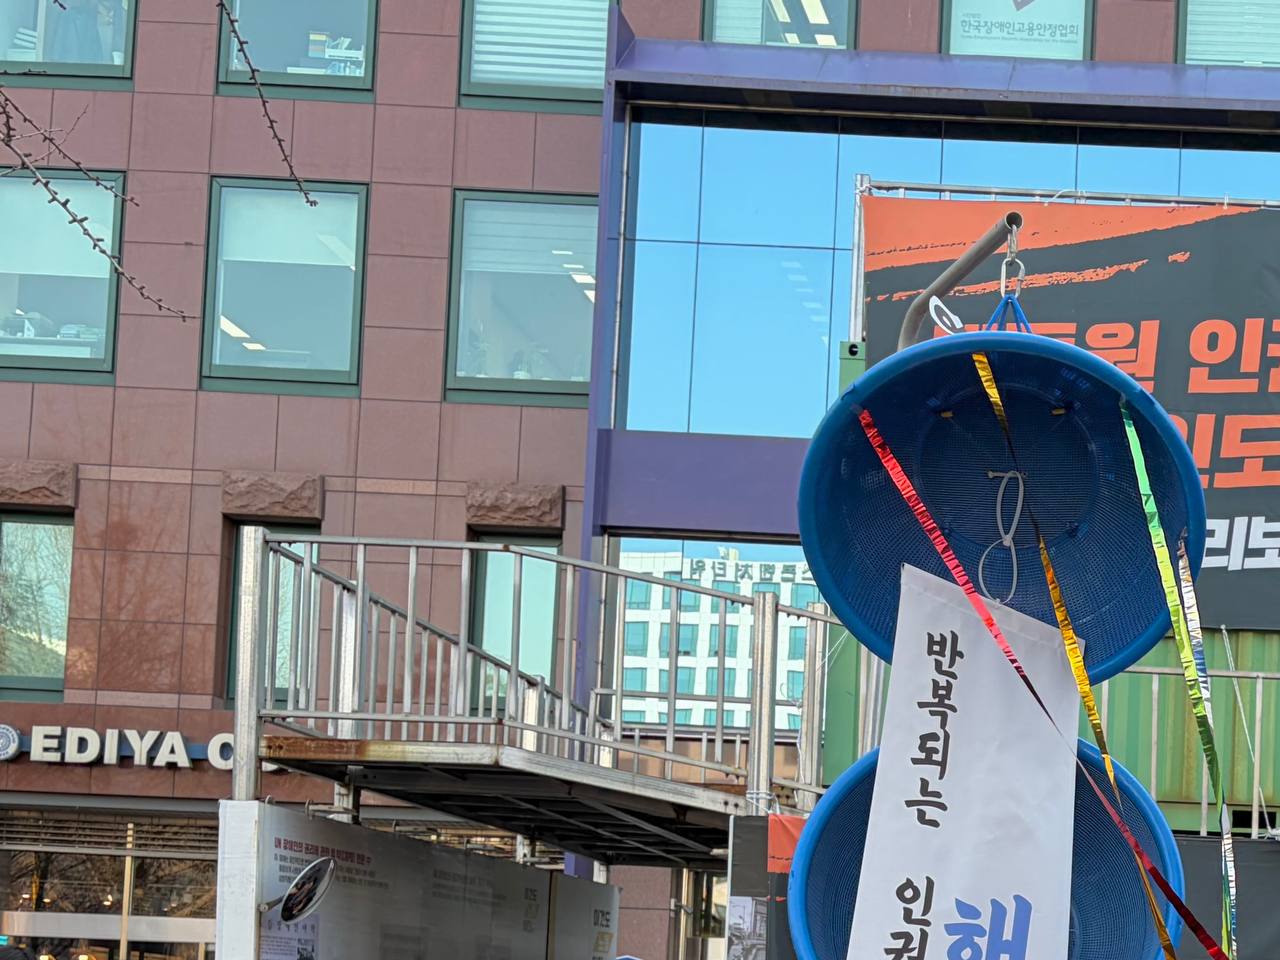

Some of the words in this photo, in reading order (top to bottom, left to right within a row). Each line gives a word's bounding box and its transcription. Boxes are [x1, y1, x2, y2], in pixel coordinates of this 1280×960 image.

[960, 19, 1079, 38] 한국장애인고용안정협회
[30, 725, 194, 769] EDIYA
[904, 630, 965, 829] 반복되는
